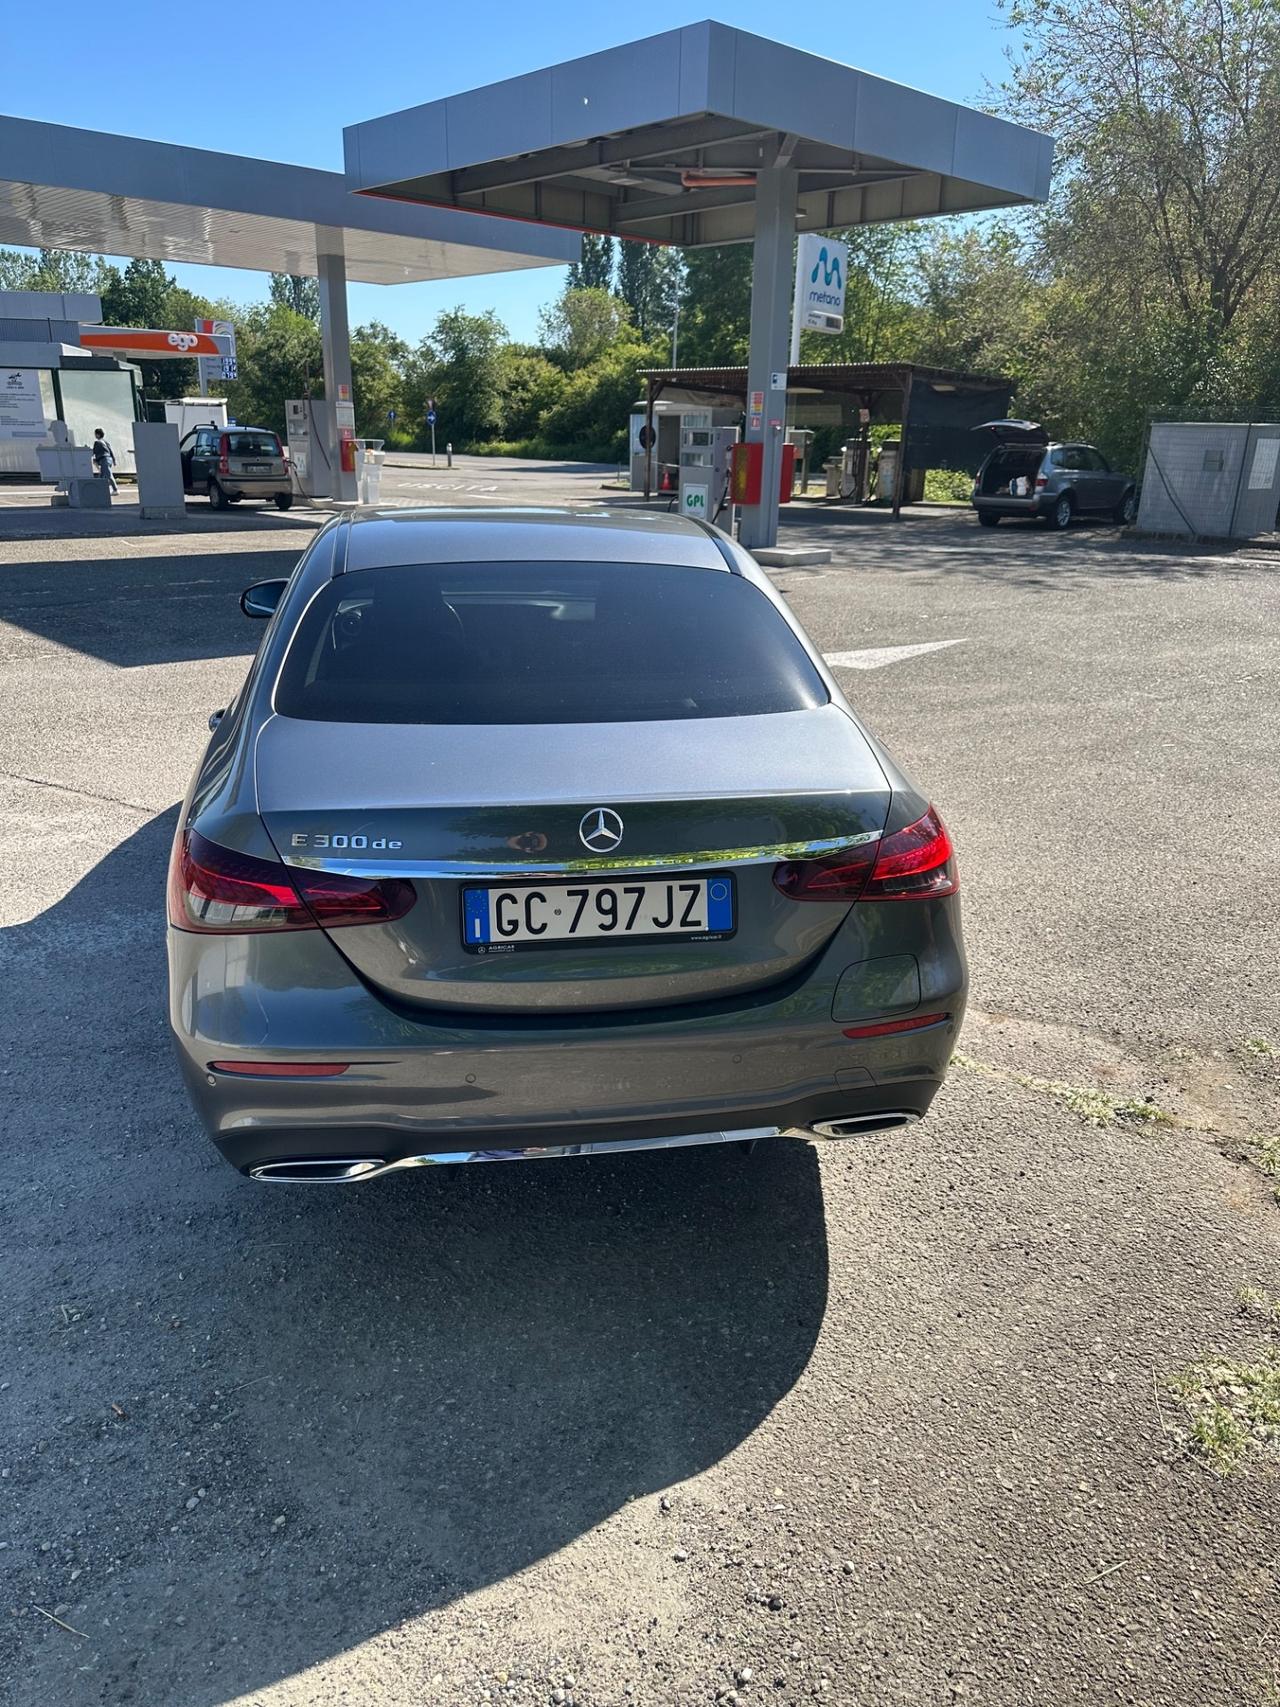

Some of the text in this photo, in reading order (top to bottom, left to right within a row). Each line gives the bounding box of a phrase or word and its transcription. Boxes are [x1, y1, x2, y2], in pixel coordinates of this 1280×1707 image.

[809, 291, 841, 306] metano
[168, 333, 198, 351] ego
[686, 494, 704, 508] GPL
